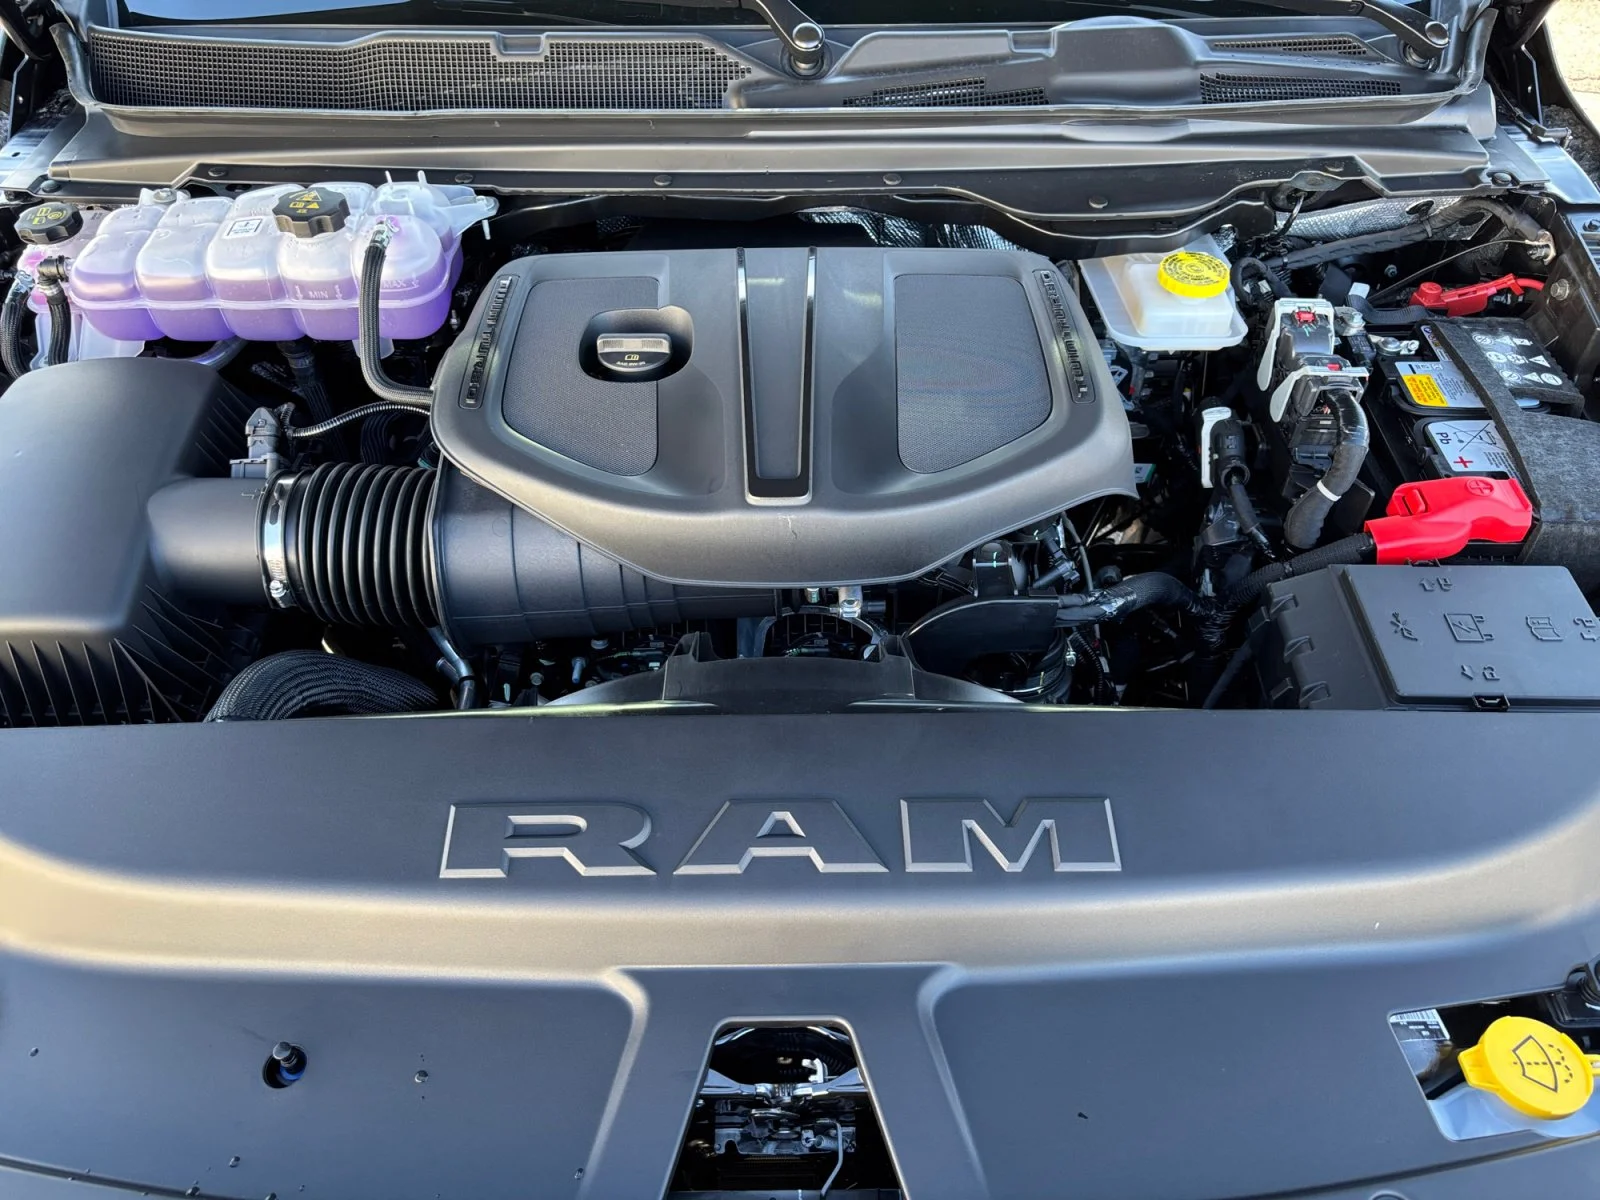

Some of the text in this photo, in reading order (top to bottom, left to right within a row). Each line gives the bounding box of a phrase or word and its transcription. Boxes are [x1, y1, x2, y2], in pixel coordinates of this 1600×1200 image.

[382, 279, 408, 289] MAX
[308, 290, 329, 299] MIN
[1436, 432, 1452, 444] Pb
[439, 798, 1123, 879] RAM
